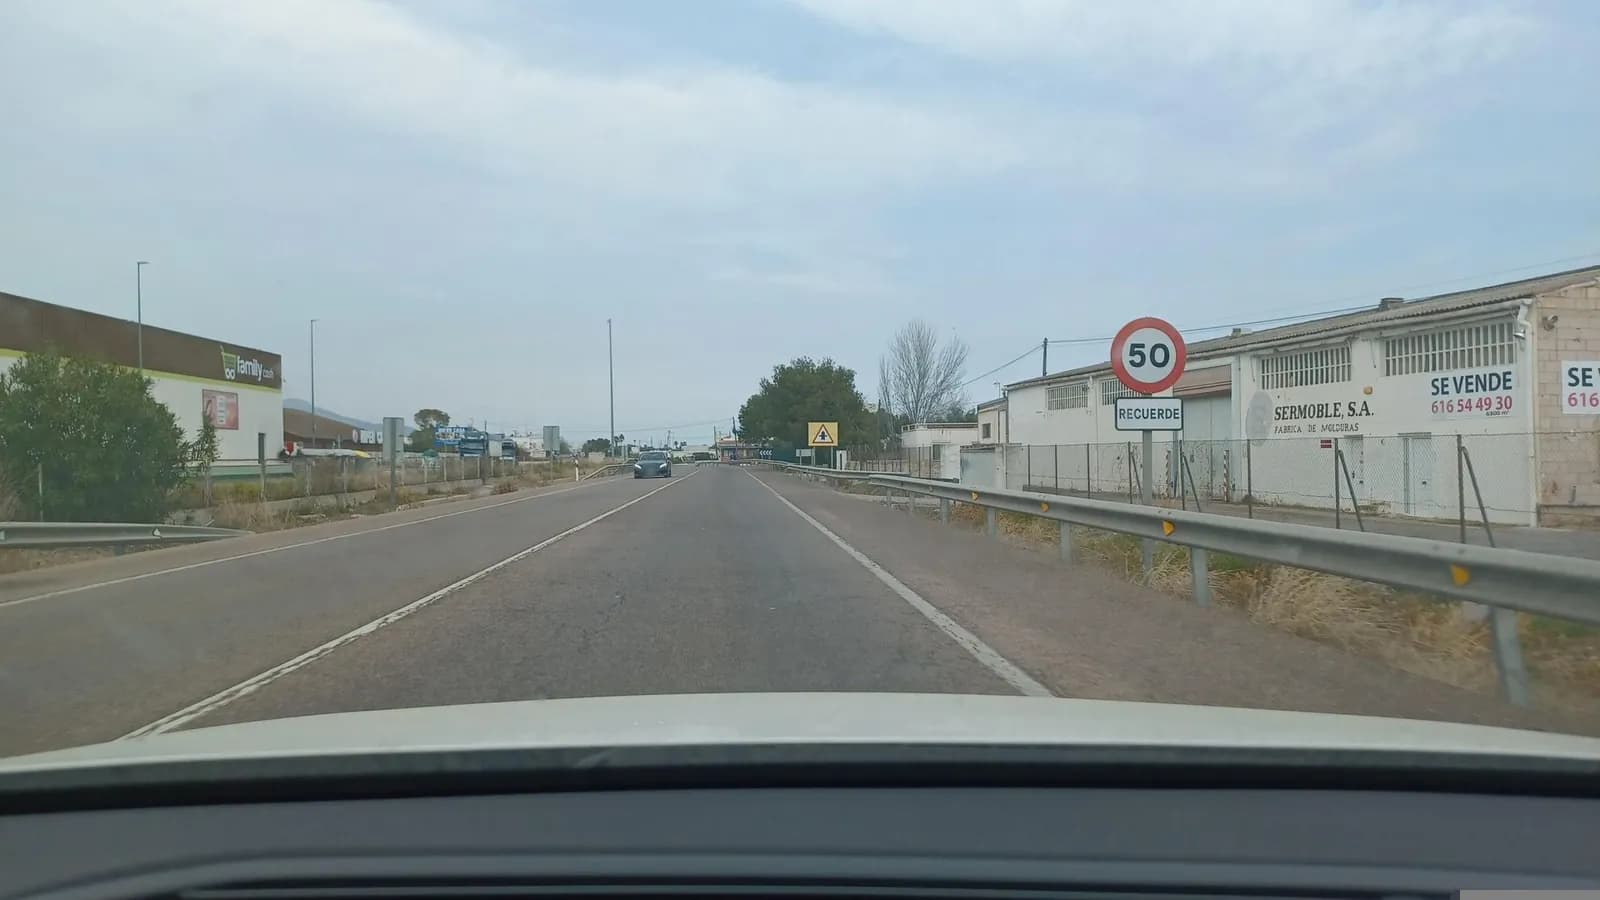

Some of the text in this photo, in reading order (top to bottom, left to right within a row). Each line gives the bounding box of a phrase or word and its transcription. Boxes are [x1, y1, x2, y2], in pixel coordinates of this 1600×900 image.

[1128, 343, 1170, 368] 50
[237, 355, 263, 382] family
[1567, 367, 1594, 387] SE
[1431, 371, 1513, 396] SE VENDE
[1431, 395, 1513, 415] 616 54 49 30
[1567, 392, 1600, 408] 616
[1119, 408, 1180, 420] RECUERDE
[1274, 400, 1375, 421] SERMOBLE, S.A.
[1308, 424, 1317, 433] DE
